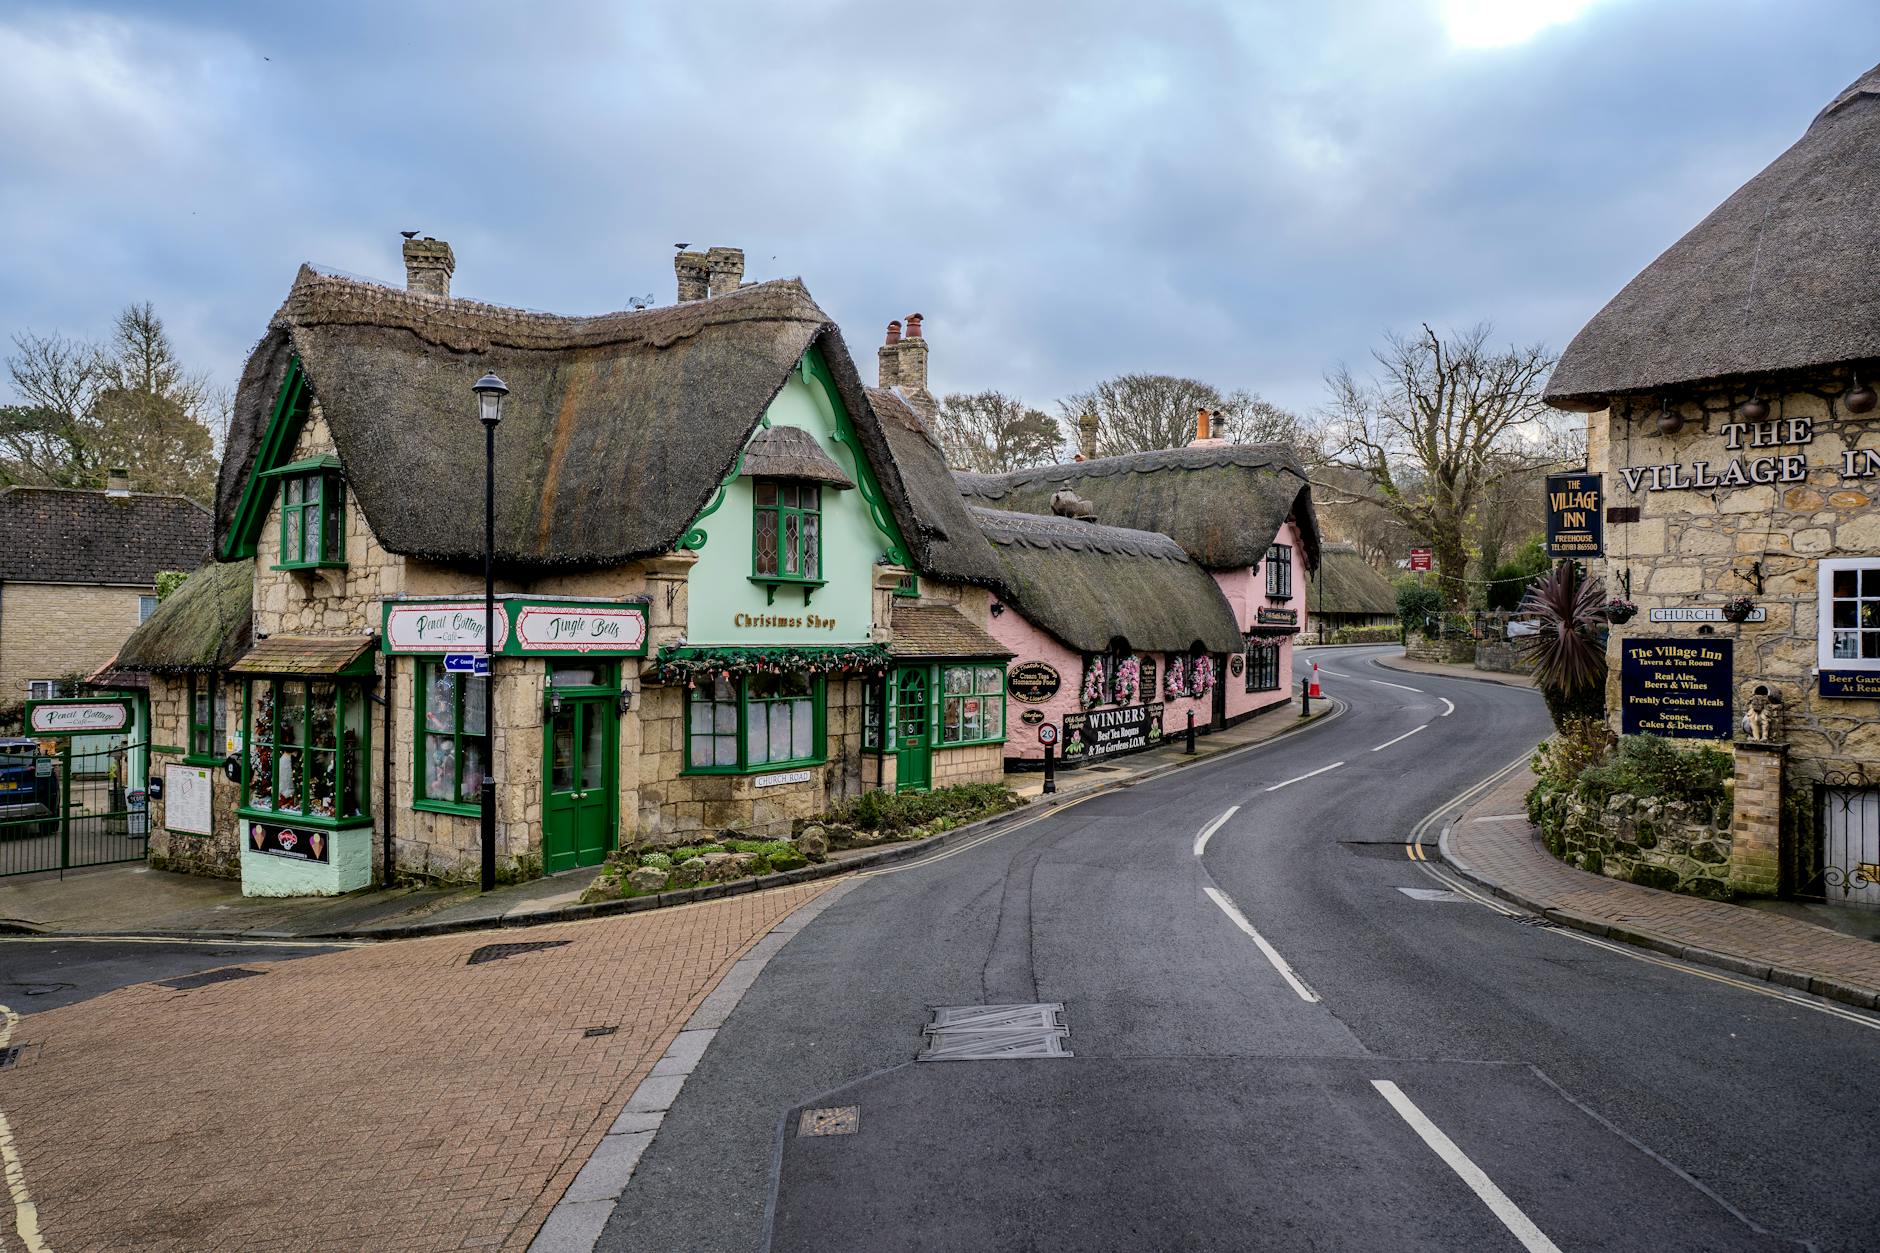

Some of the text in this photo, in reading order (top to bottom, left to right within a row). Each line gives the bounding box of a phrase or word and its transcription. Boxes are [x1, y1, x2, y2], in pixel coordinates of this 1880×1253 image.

[1721, 416, 1813, 450] THE
[1619, 453, 1807, 493] VILLAGE
[1567, 480, 1581, 490] THE
[1550, 491, 1598, 513] VILLAGE
[1563, 512, 1586, 528] INN
[1654, 609, 1715, 620] CHURCH
[416, 612, 486, 640] Pencil Cottage
[546, 617, 621, 641] Jingle Bells
[734, 613, 837, 631] Christmas Shop
[1629, 646, 1723, 660] The Village Inn
[1689, 659, 1714, 667] Rooms
[1020, 672, 1050, 680] Cream Teas
[1655, 672, 1697, 682] Real Ales,
[1828, 674, 1854, 683] Beer
[1644, 680, 1708, 690] Beers & Wines
[1841, 684, 1854, 692] At
[1629, 695, 1724, 707] Freshly Cooked Meals
[46, 709, 115, 724] Pencil Cottage
[1089, 707, 1146, 729] WINNERS
[1660, 712, 1691, 722] Scones,
[1639, 719, 1714, 731] Cakes & Desserts
[1041, 729, 1055, 739] 20
[1097, 726, 1140, 742] Best Tea Rooms
[1088, 745, 1095, 757] &
[1095, 744, 1105, 755] Tea
[1105, 739, 1129, 753] Gardens
[758, 772, 809, 786] CHURCH ROAD
